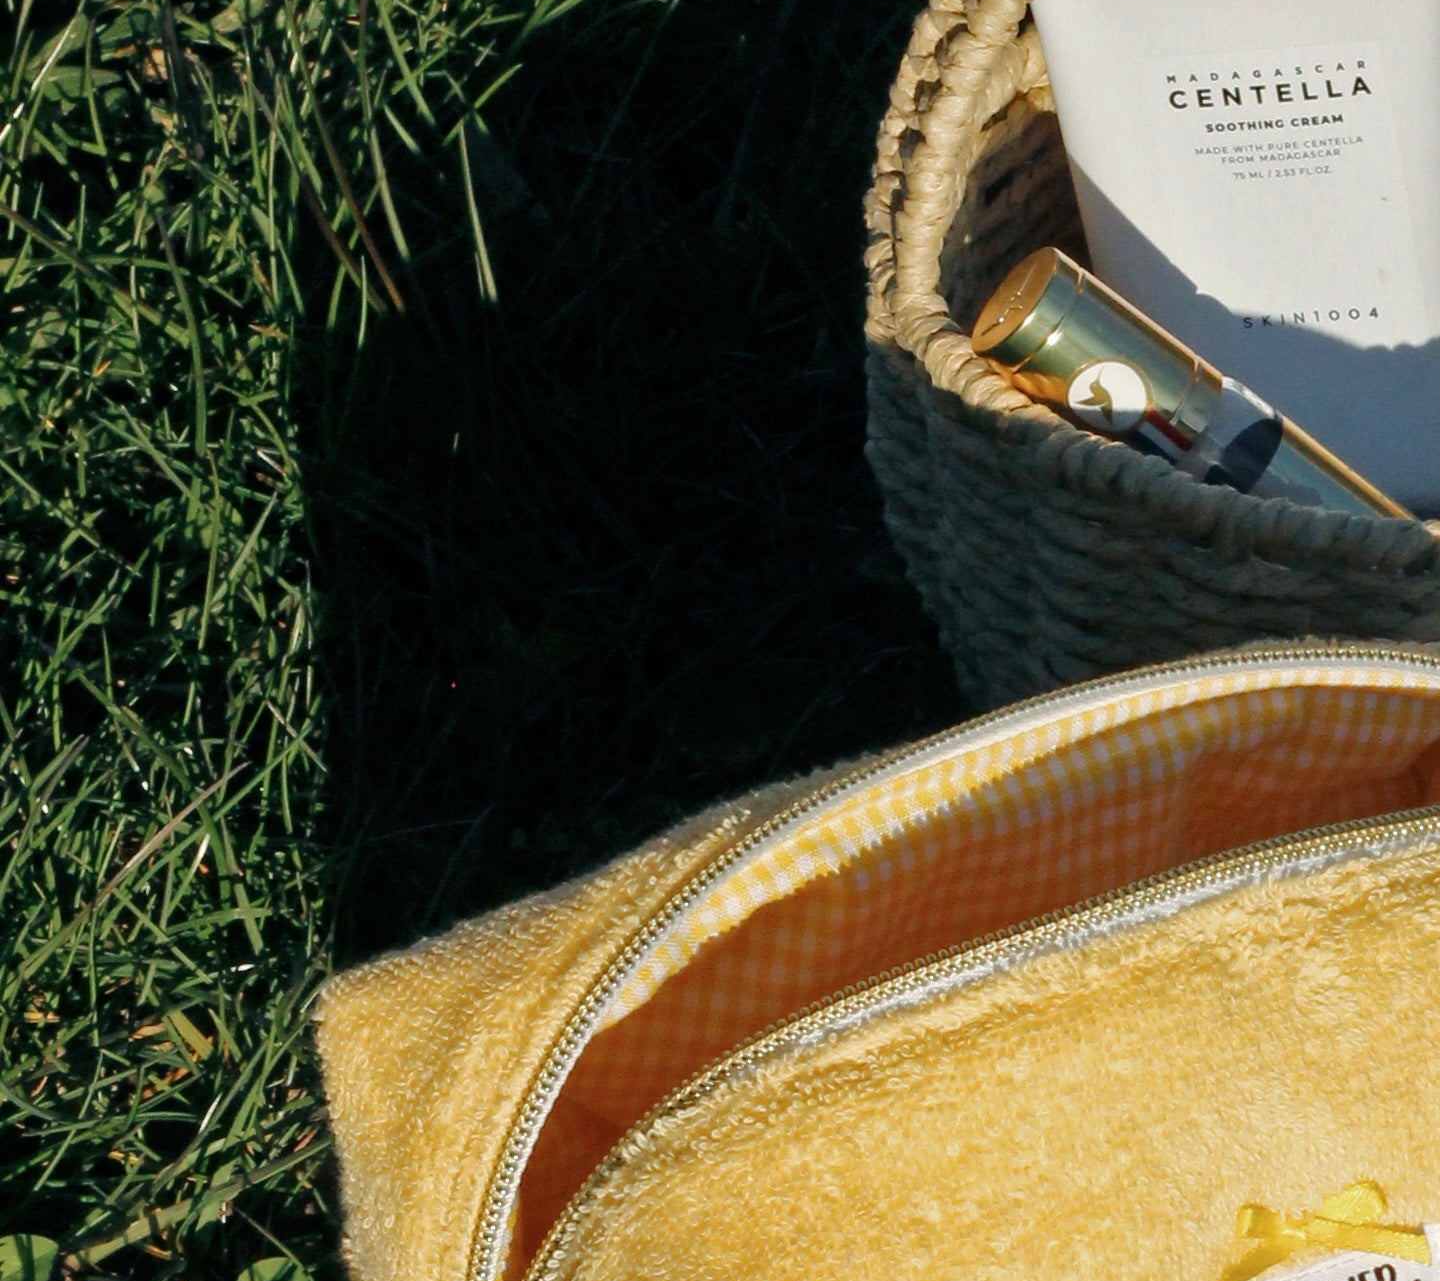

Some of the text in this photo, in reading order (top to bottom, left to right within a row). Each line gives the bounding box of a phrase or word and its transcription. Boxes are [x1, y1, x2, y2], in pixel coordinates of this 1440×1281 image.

[1166, 60, 1366, 84] MADAGASCAR
[1169, 76, 1372, 109] CENTELLA
[1205, 114, 1344, 133] SOOTHING CREAM
[1195, 136, 1363, 156] MADE WITH PURE CENTELLA
[1221, 149, 1341, 164] FROM MADAGASCAR
[1249, 171, 1264, 179] ML
[1243, 306, 1380, 329] SKIN1004
